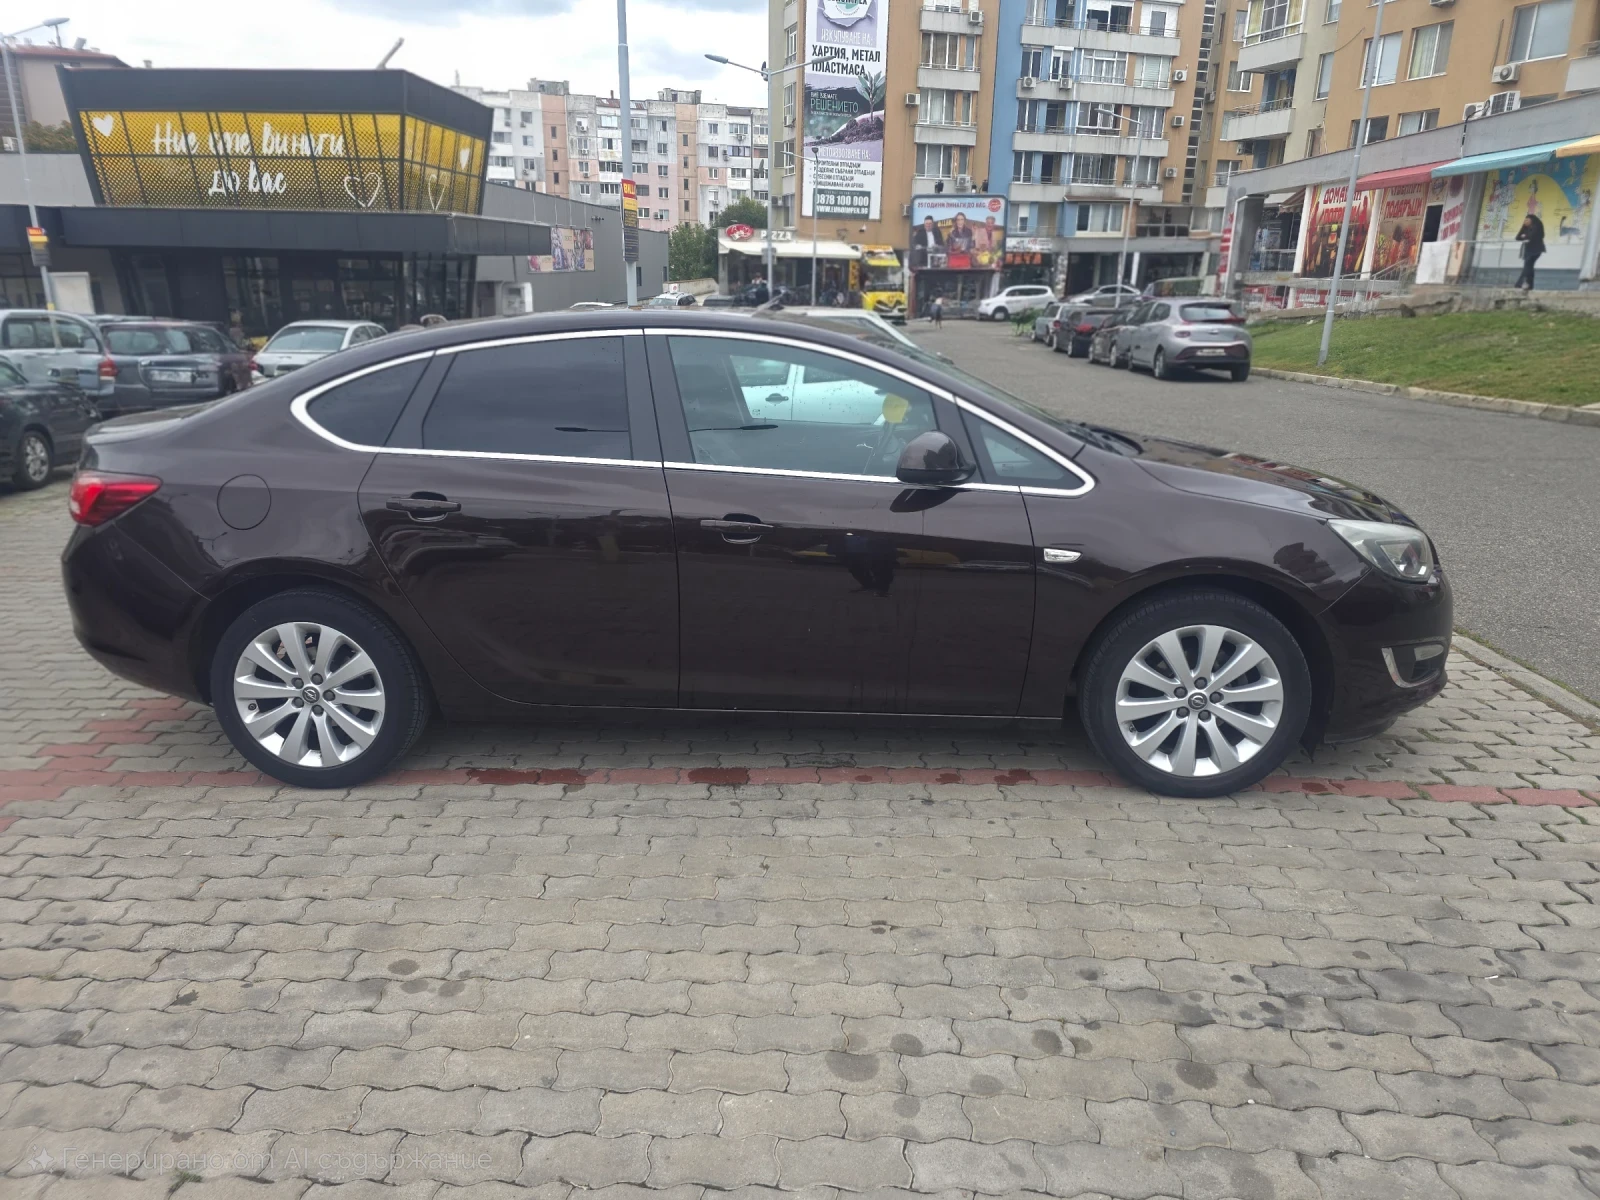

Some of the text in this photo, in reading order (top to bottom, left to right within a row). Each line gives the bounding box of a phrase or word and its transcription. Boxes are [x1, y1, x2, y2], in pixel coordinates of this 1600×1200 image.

[821, 28, 861, 45] ИЗКУПУВАНЕ
[811, 44, 881, 63] ХАРТИЯ, МЕТАЛ
[811, 60, 866, 76] ПЛАСТМАСА
[810, 98, 859, 113] РЕШЕНИЕТО
[152, 120, 199, 156] Ние
[207, 158, 287, 197] до вас
[836, 195, 852, 206] 100
[760, 230, 792, 241] PZZA
